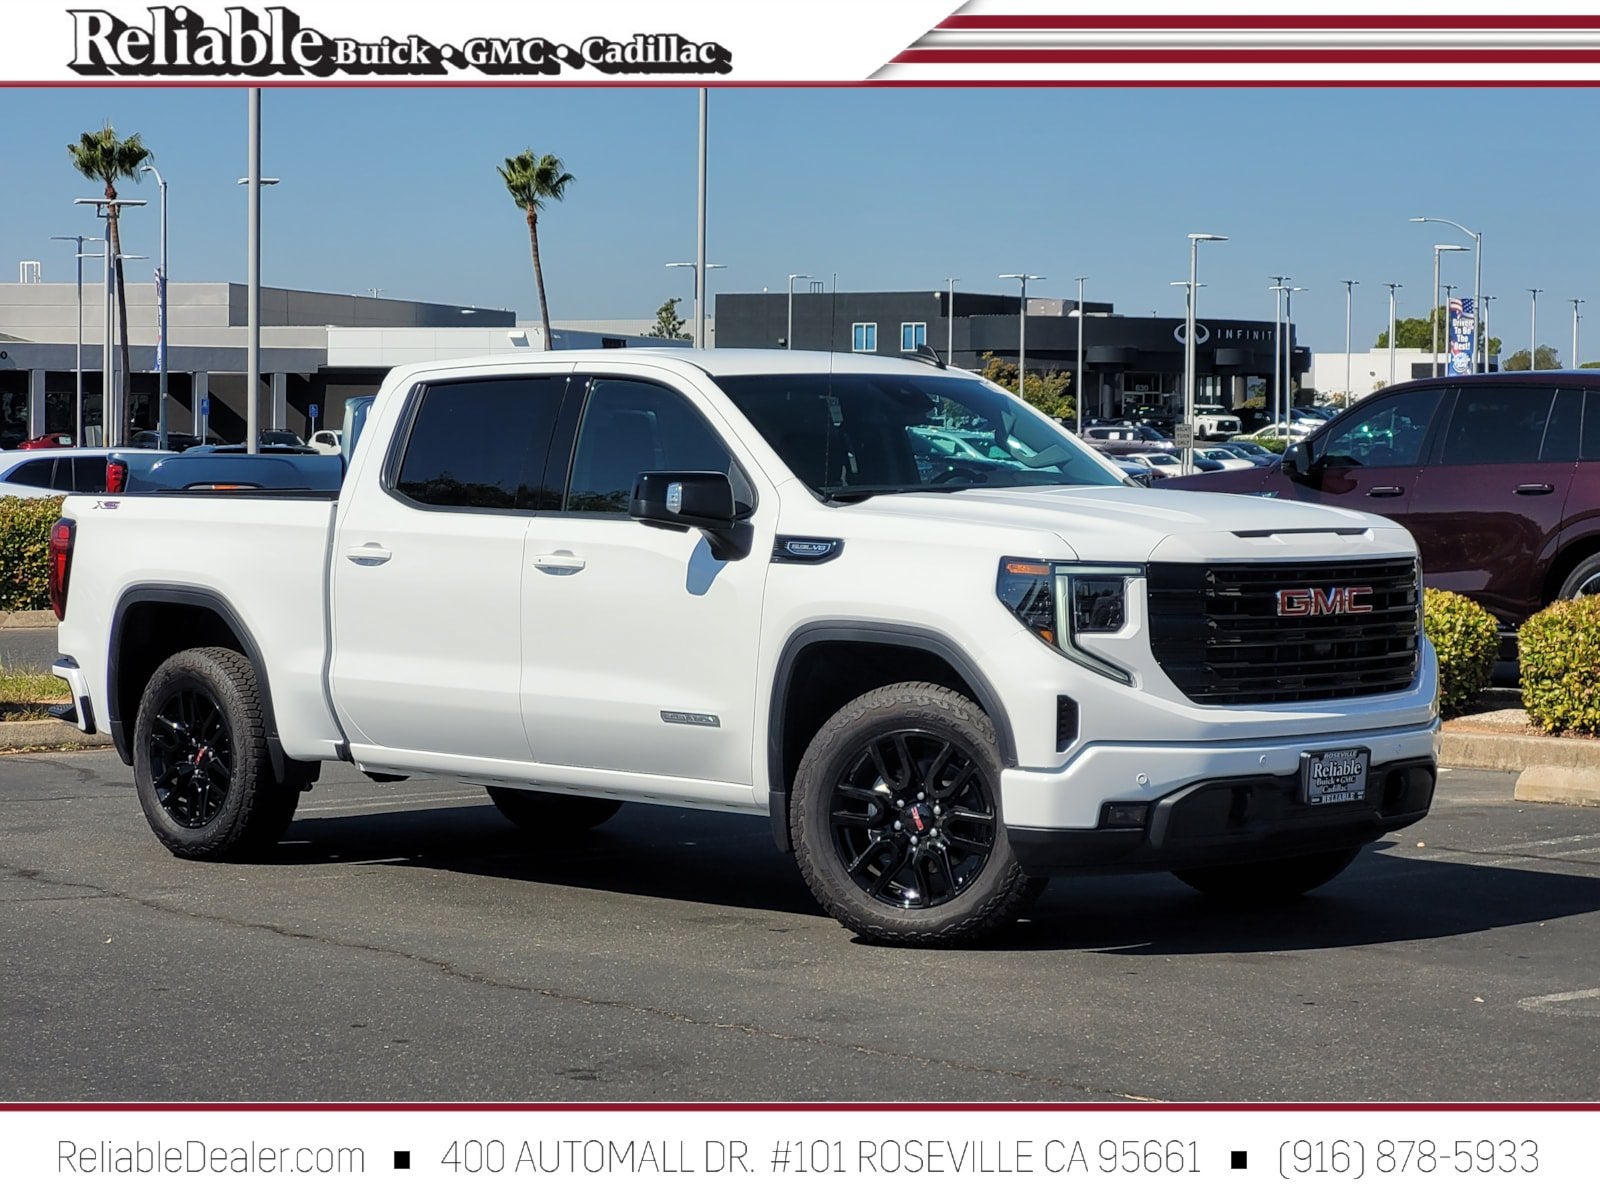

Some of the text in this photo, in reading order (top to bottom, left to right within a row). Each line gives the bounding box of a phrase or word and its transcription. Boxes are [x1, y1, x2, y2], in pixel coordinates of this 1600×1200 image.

[1452, 319, 1474, 327] Driven
[1217, 328, 1273, 340] INFINIT
[1463, 326, 1471, 335] Be
[1454, 342, 1471, 351] Best!
[1276, 587, 1373, 616] GMC
[1313, 760, 1361, 778] Reliable
[1316, 776, 1356, 786] Buick GMC
[1322, 785, 1347, 793] Cadillac
[1322, 792, 1355, 803] RELIABLE
